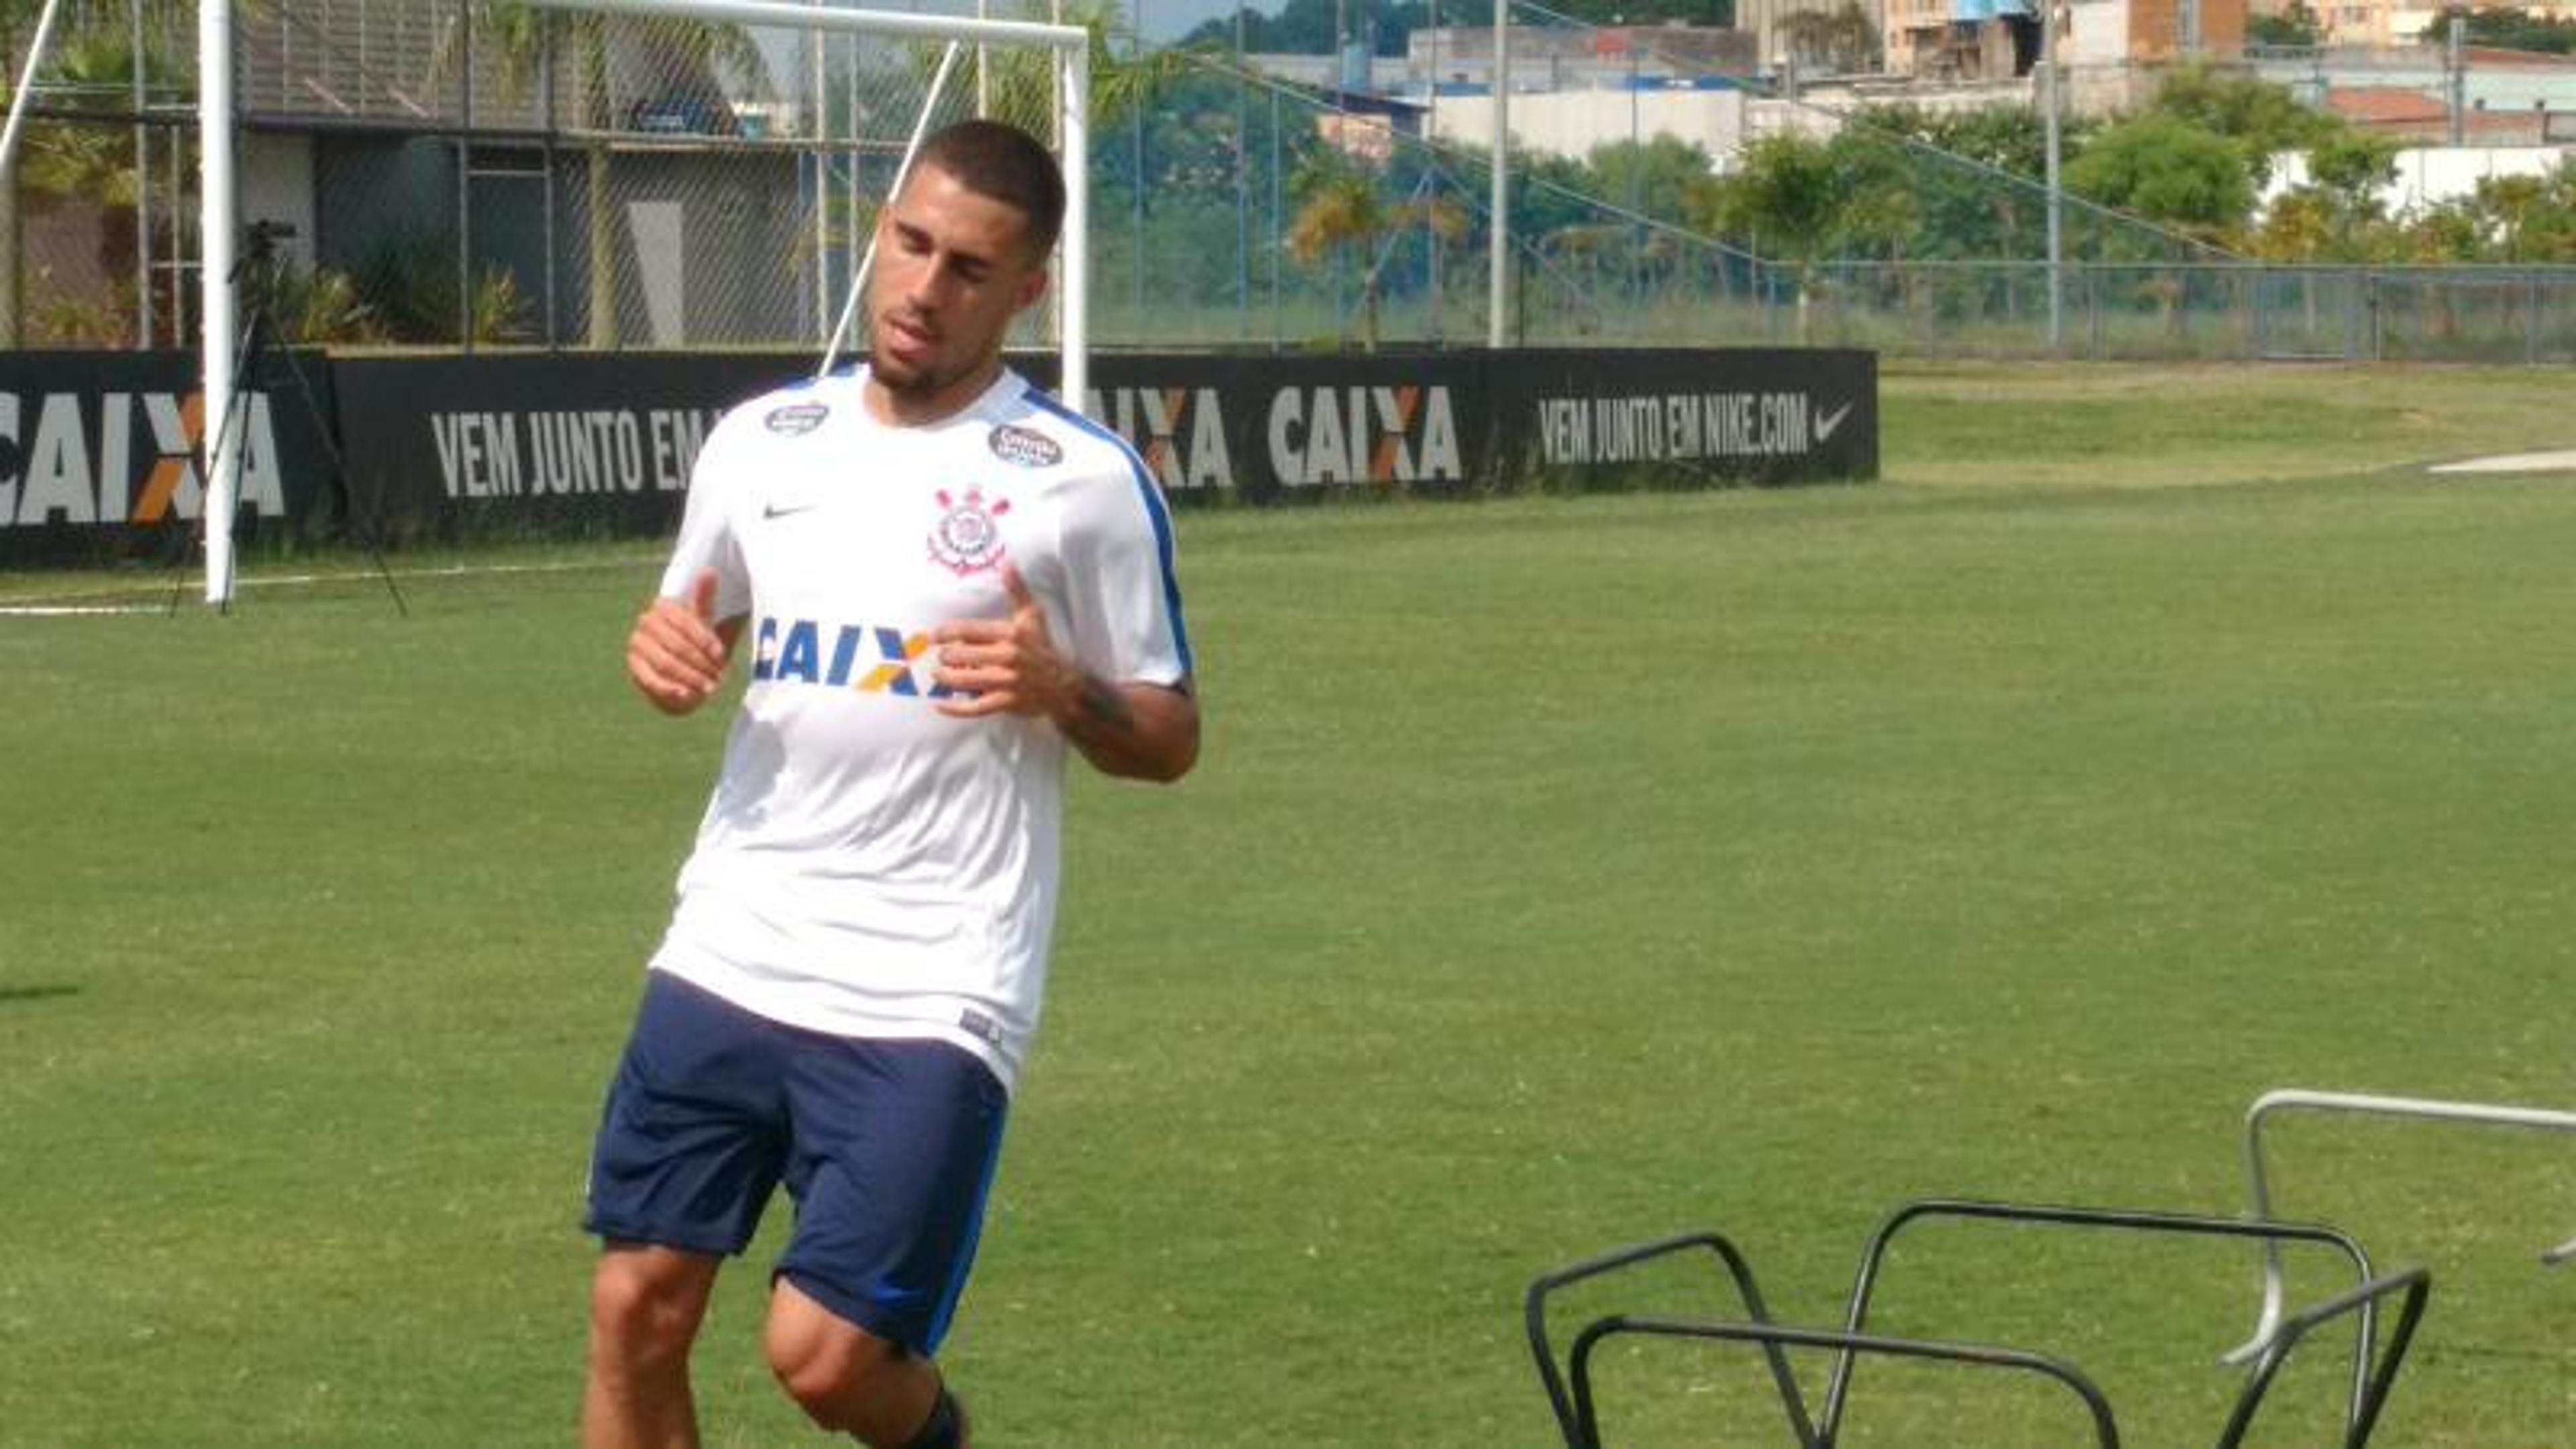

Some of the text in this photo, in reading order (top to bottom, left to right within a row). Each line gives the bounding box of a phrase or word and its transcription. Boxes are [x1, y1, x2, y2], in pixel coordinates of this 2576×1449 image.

[431, 408, 705, 496] VEM JUNTO EM
[1268, 386, 1462, 486] CAIXA
[1540, 392, 1808, 464] VEM JUNTO EM NIKE.COM
[755, 617, 982, 699] CAIX
